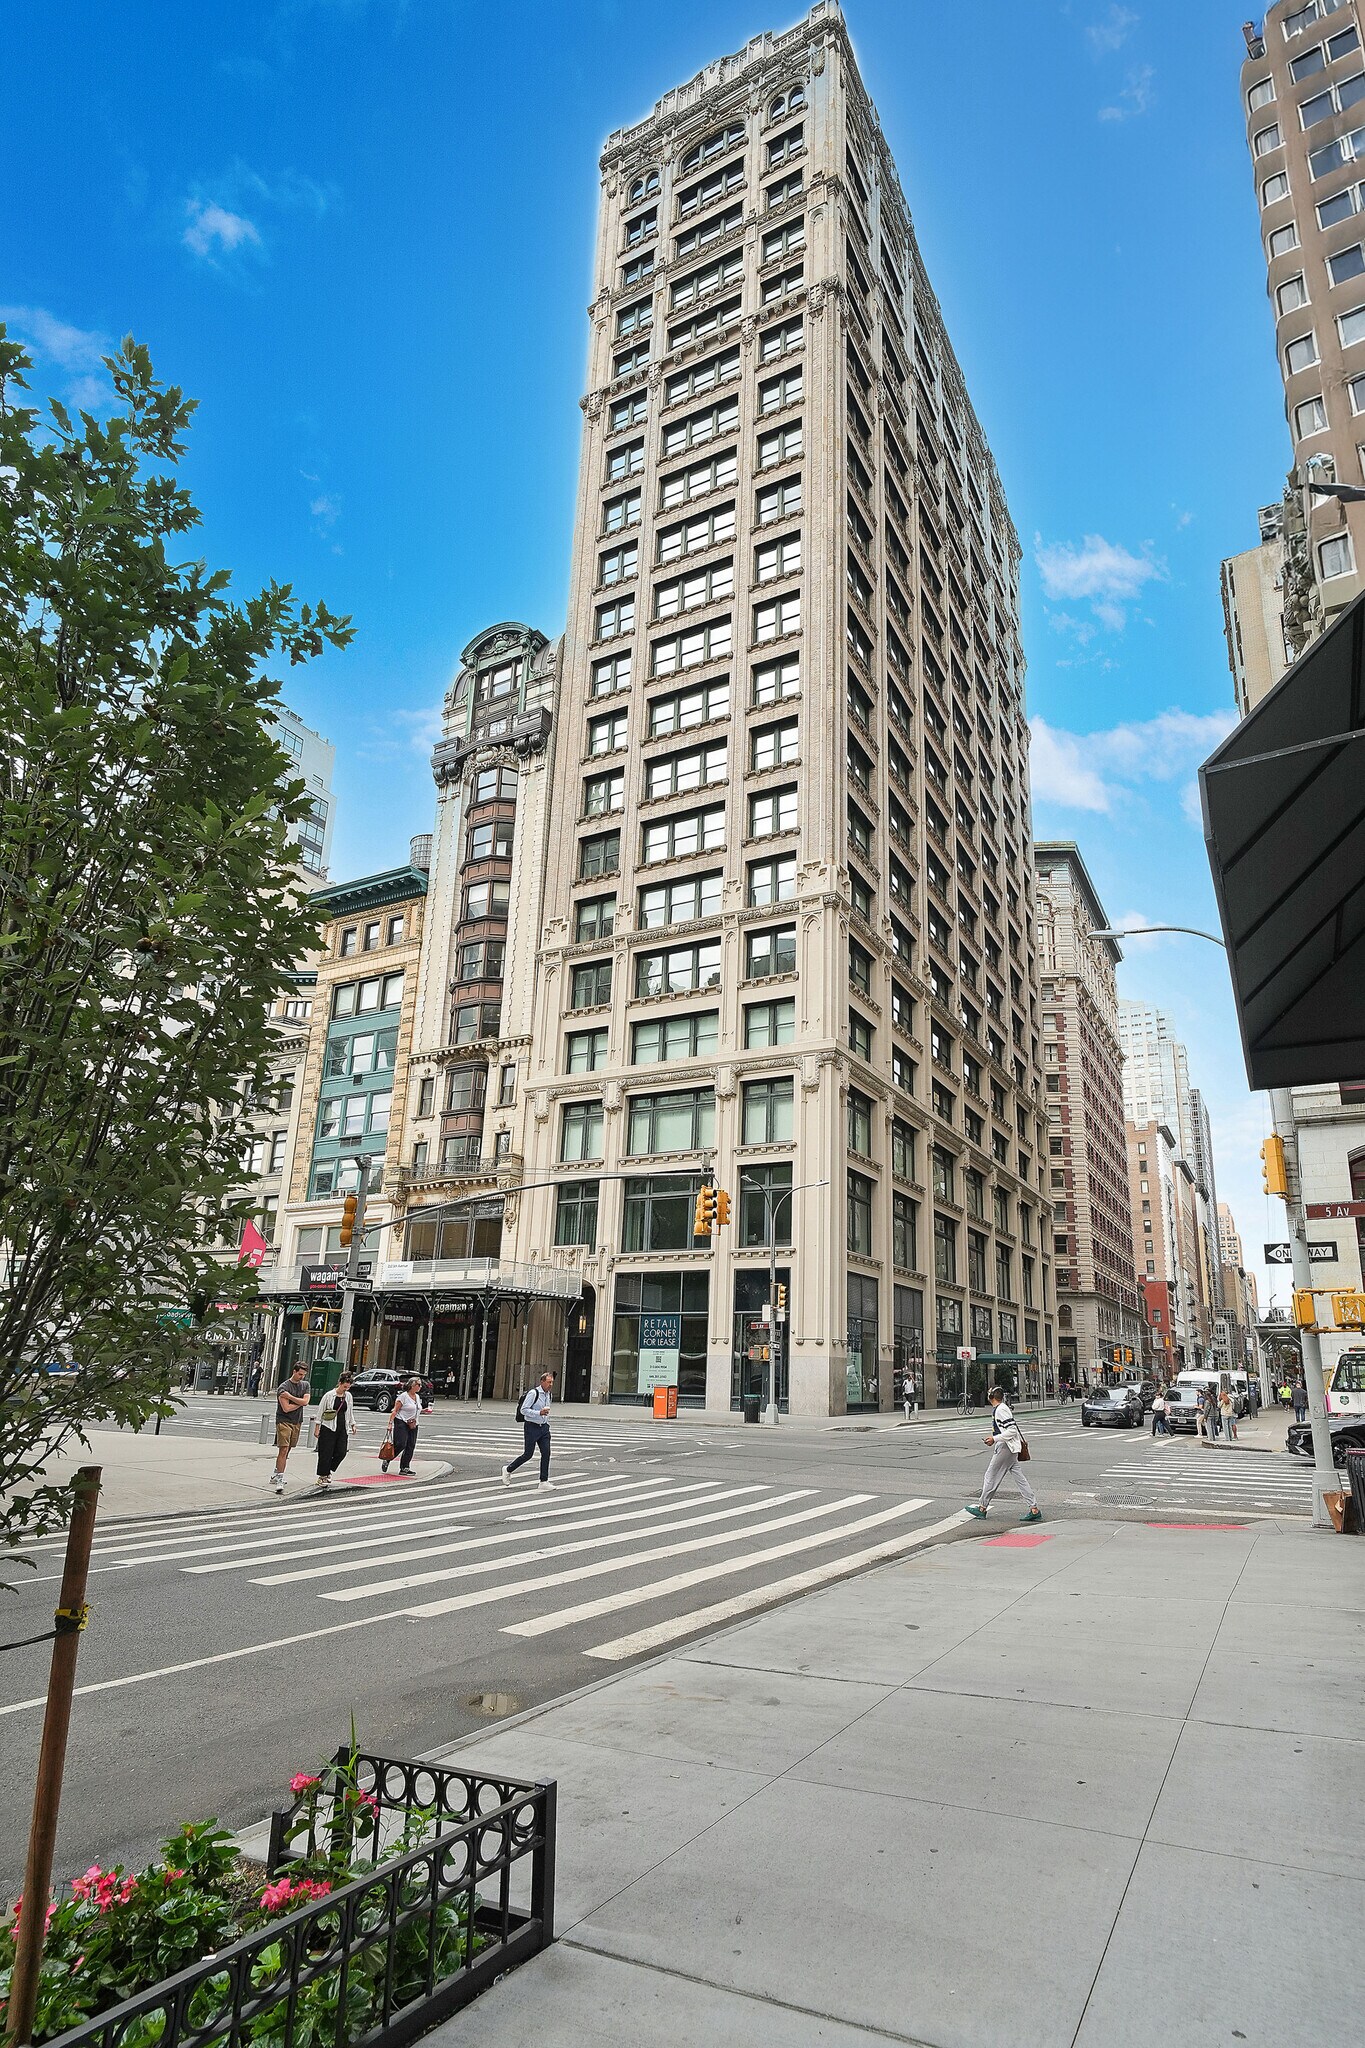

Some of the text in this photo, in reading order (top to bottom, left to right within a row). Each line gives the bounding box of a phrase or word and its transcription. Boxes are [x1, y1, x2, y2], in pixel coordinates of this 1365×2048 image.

[1325, 1205, 1350, 1217] 5 Av
[341, 1280, 353, 1288] ONE
[358, 1282, 370, 1290] WAY
[644, 1319, 677, 1328] RETAIL
[643, 1329, 677, 1338] CORNER
[643, 1338, 676, 1346] FOR LEASE
